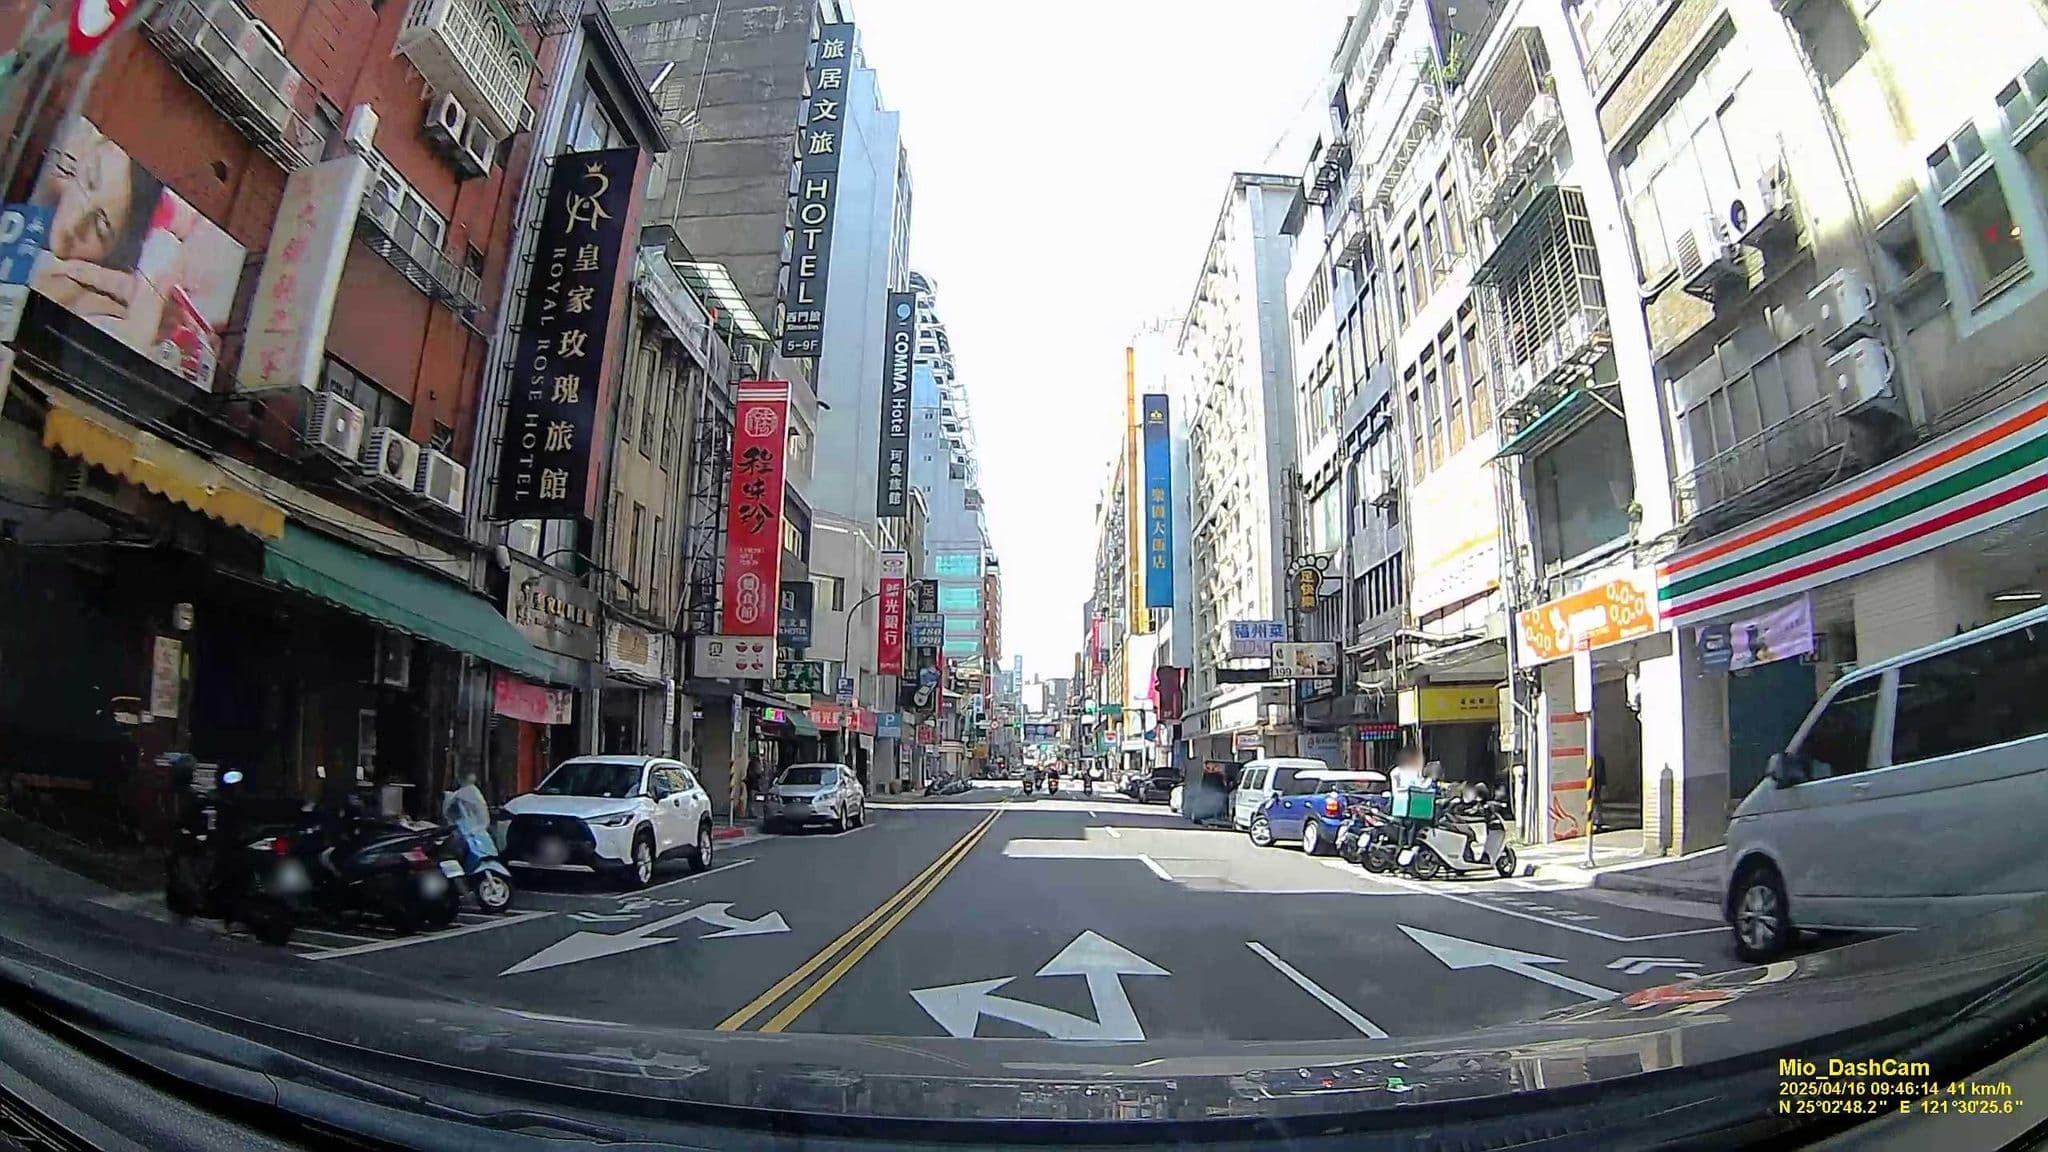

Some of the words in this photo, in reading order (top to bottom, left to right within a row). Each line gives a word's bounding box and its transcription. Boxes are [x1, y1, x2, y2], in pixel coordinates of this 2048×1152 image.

[808, 38, 845, 154] 旅居文旅
[799, 179, 828, 304] HOTEL
[541, 247, 567, 326] ROYAL
[528, 339, 551, 401] ROSE
[539, 243, 600, 500] 皇家玫瑰旅館
[787, 340, 819, 350] 5-9F
[893, 332, 909, 393] COMMA
[890, 398, 906, 437] Hotel
[515, 413, 539, 501] HOTEL
[884, 583, 900, 646] 新光銀行
[1235, 623, 1284, 638] 福州菜
[885, 714, 895, 726] P
